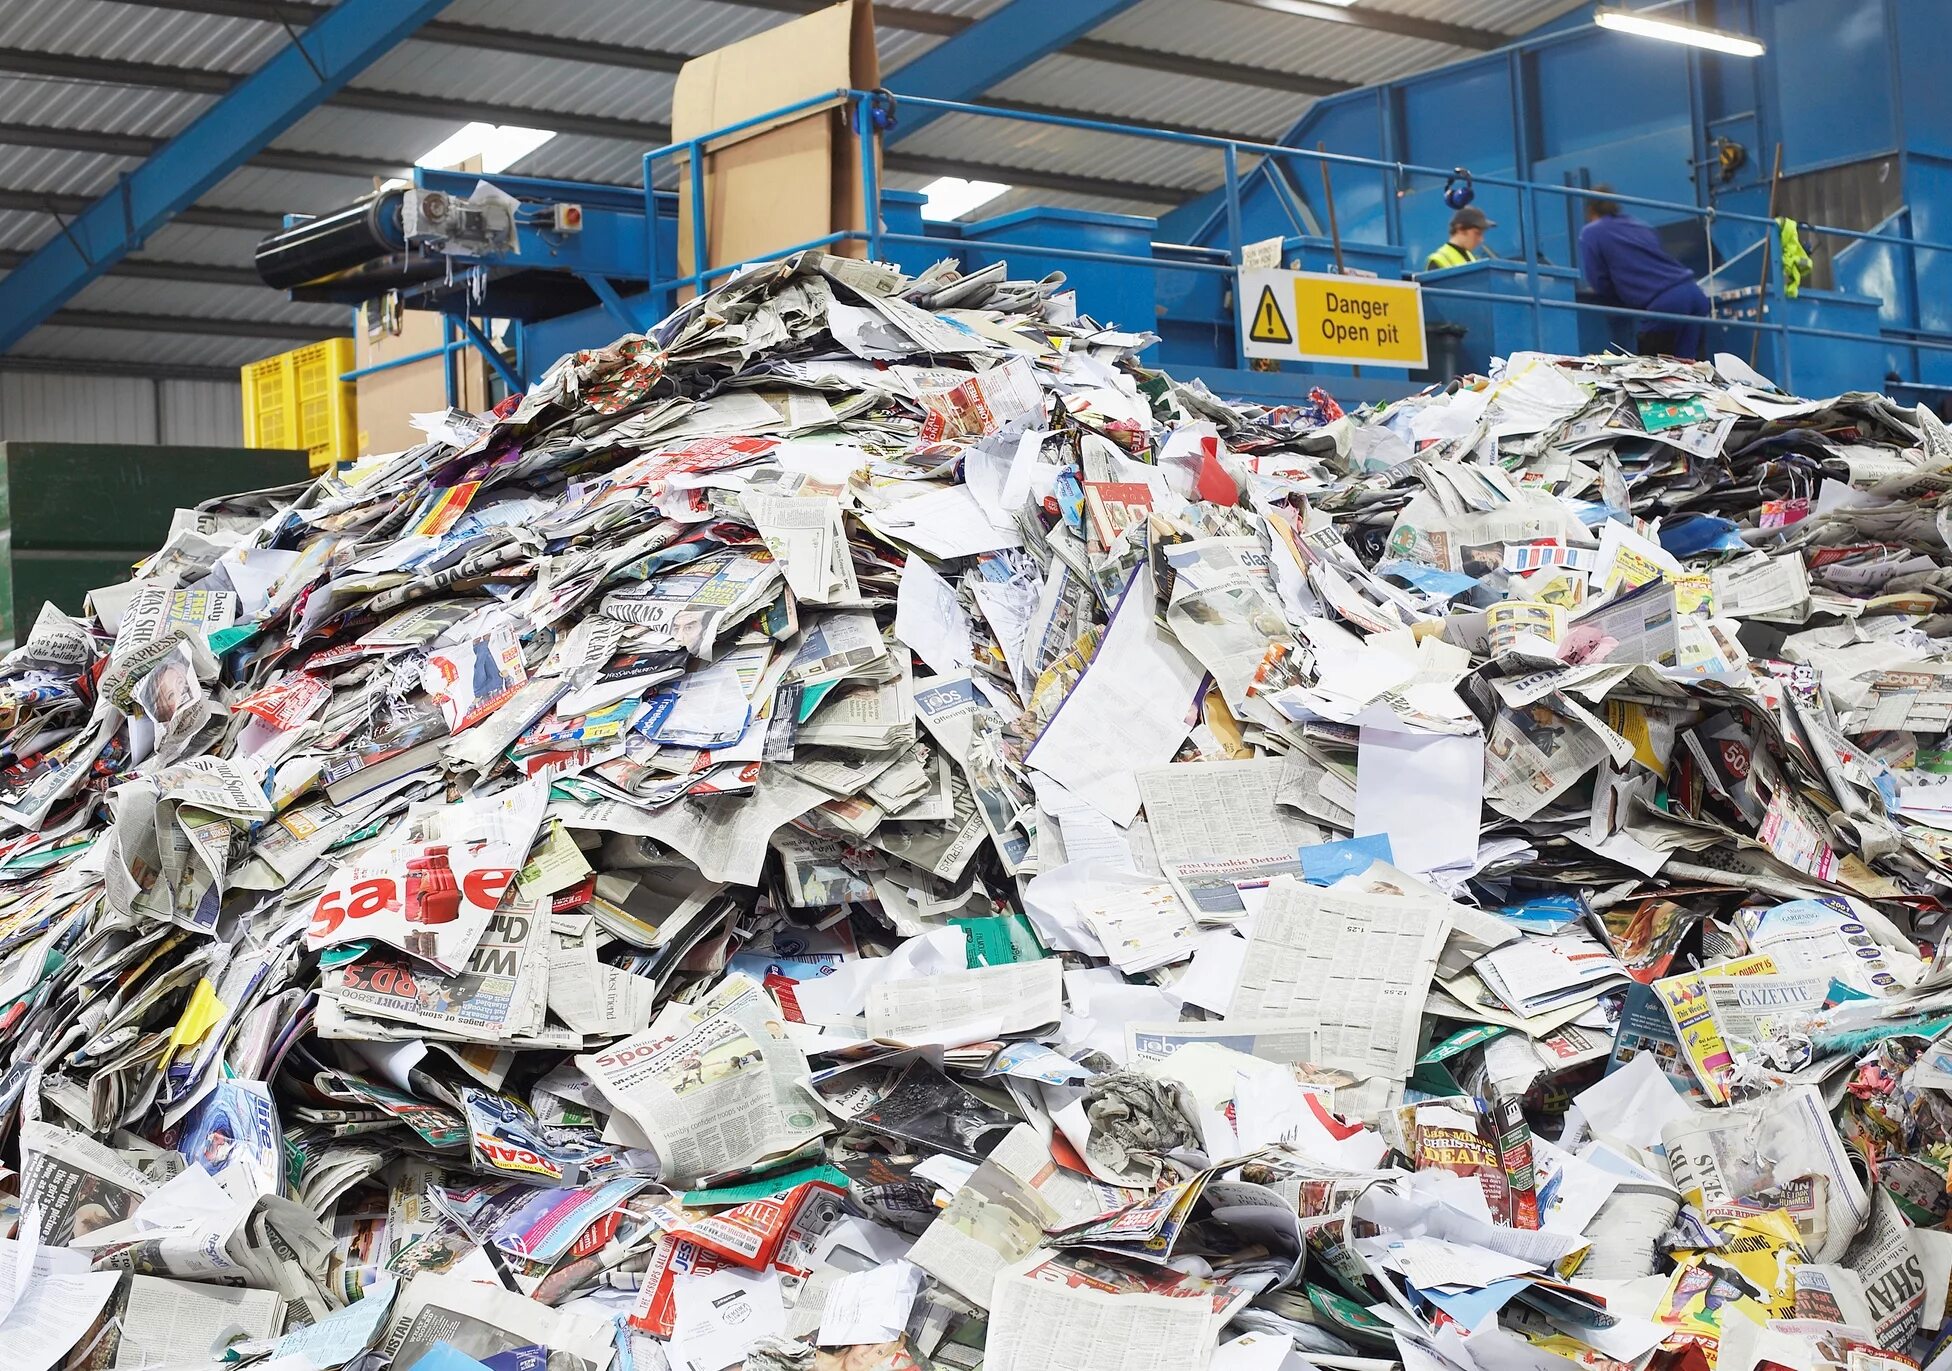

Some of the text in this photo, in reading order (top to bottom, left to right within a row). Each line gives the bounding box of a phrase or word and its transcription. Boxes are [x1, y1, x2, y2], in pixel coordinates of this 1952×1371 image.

[1326, 293, 1389, 319] Danger
[1321, 319, 1399, 346] Open pit
[140, 588, 165, 617] WAS
[192, 590, 206, 621] FREE
[214, 591, 229, 624] Daily
[924, 687, 962, 715] jobs
[228, 777, 250, 811] Squad
[1203, 857, 1249, 869] Frankie
[1250, 853, 1293, 864] Dettori
[341, 989, 375, 1004] £800
[608, 992, 619, 1020] friend
[1738, 987, 1813, 1007] GAZETTE
[445, 1014, 456, 1023] of
[457, 1015, 486, 1029] pages
[689, 1111, 718, 1131] confident
[717, 1107, 737, 1122] troops
[480, 1142, 561, 1174] OCAR
[1423, 1147, 1499, 1168] DEALS
[1782, 1180, 1809, 1191] WIN
[1779, 1196, 1811, 1207] HUMMER
[42, 1206, 62, 1238] picture
[736, 1203, 773, 1226] SALE
[1871, 1257, 1891, 1274] Blairs
[640, 1253, 667, 1310] THE JESSOPS SALE
